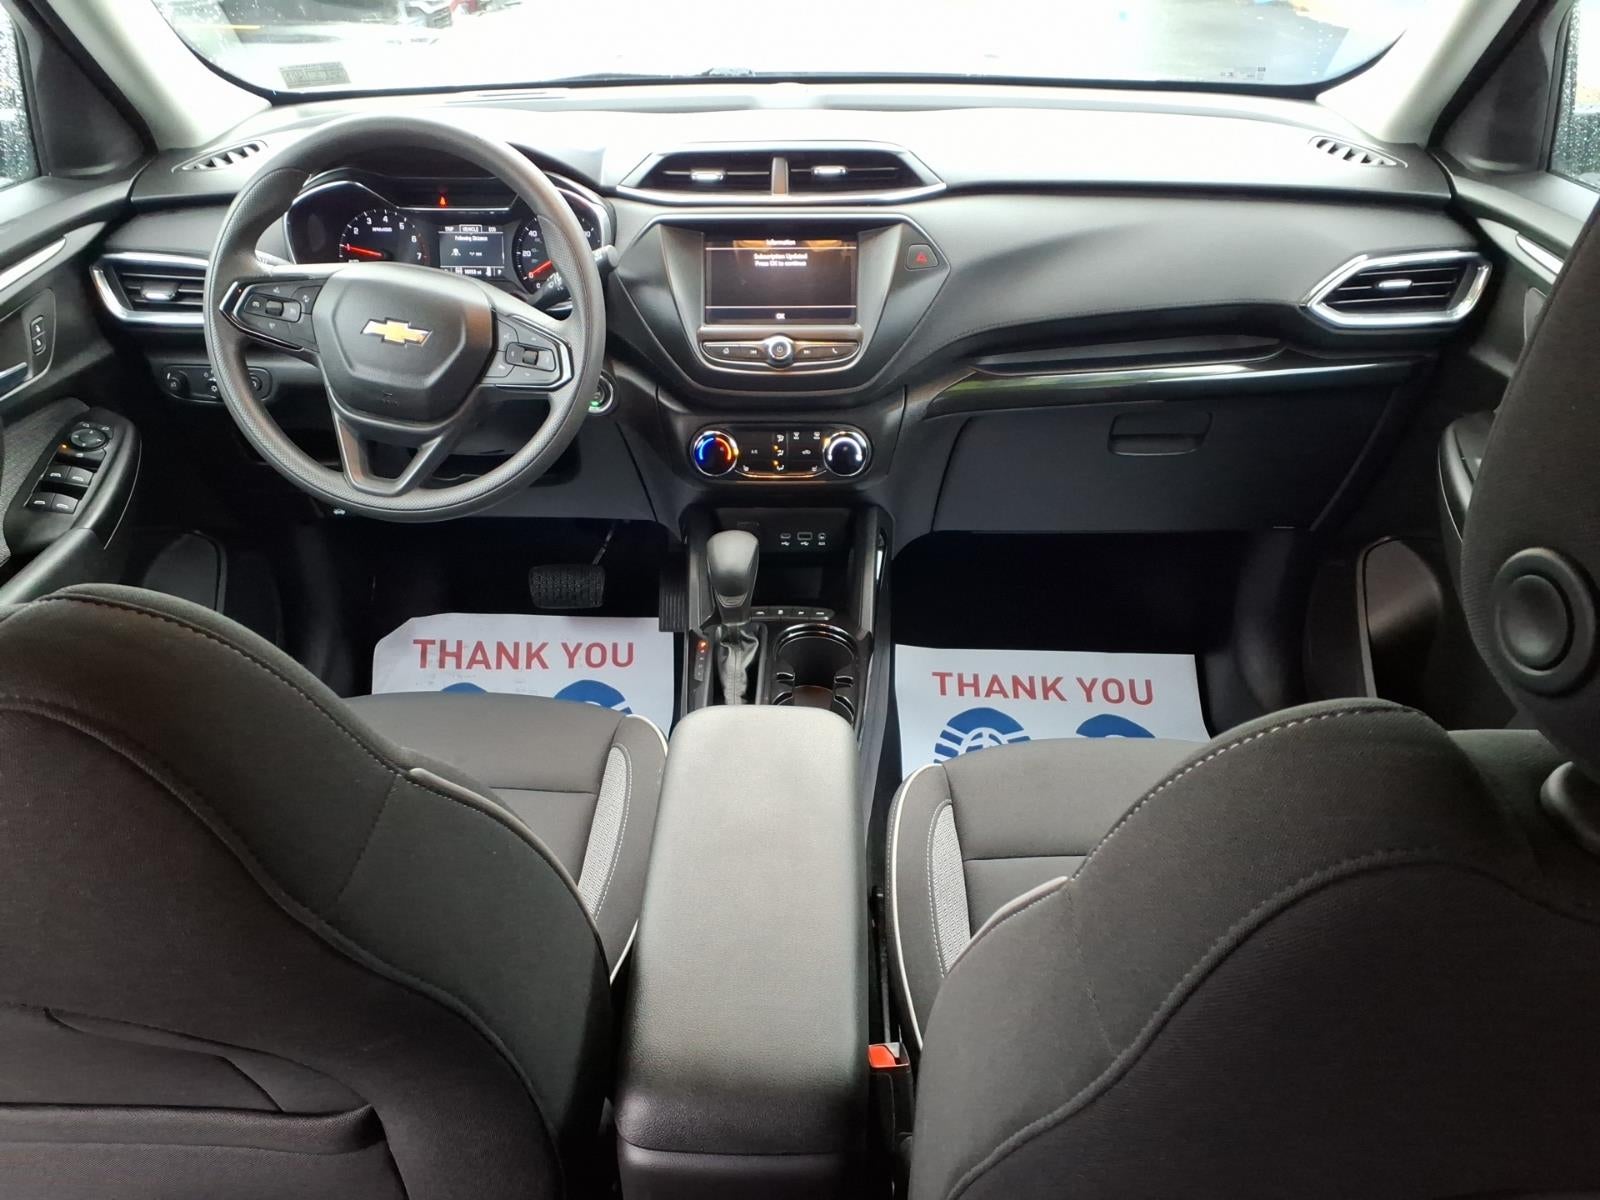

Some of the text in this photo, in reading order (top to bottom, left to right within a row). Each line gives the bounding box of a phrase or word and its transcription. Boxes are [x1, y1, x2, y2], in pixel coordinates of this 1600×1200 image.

[412, 639, 635, 671] THANK YOU
[931, 671, 1154, 706] THANK YOU
